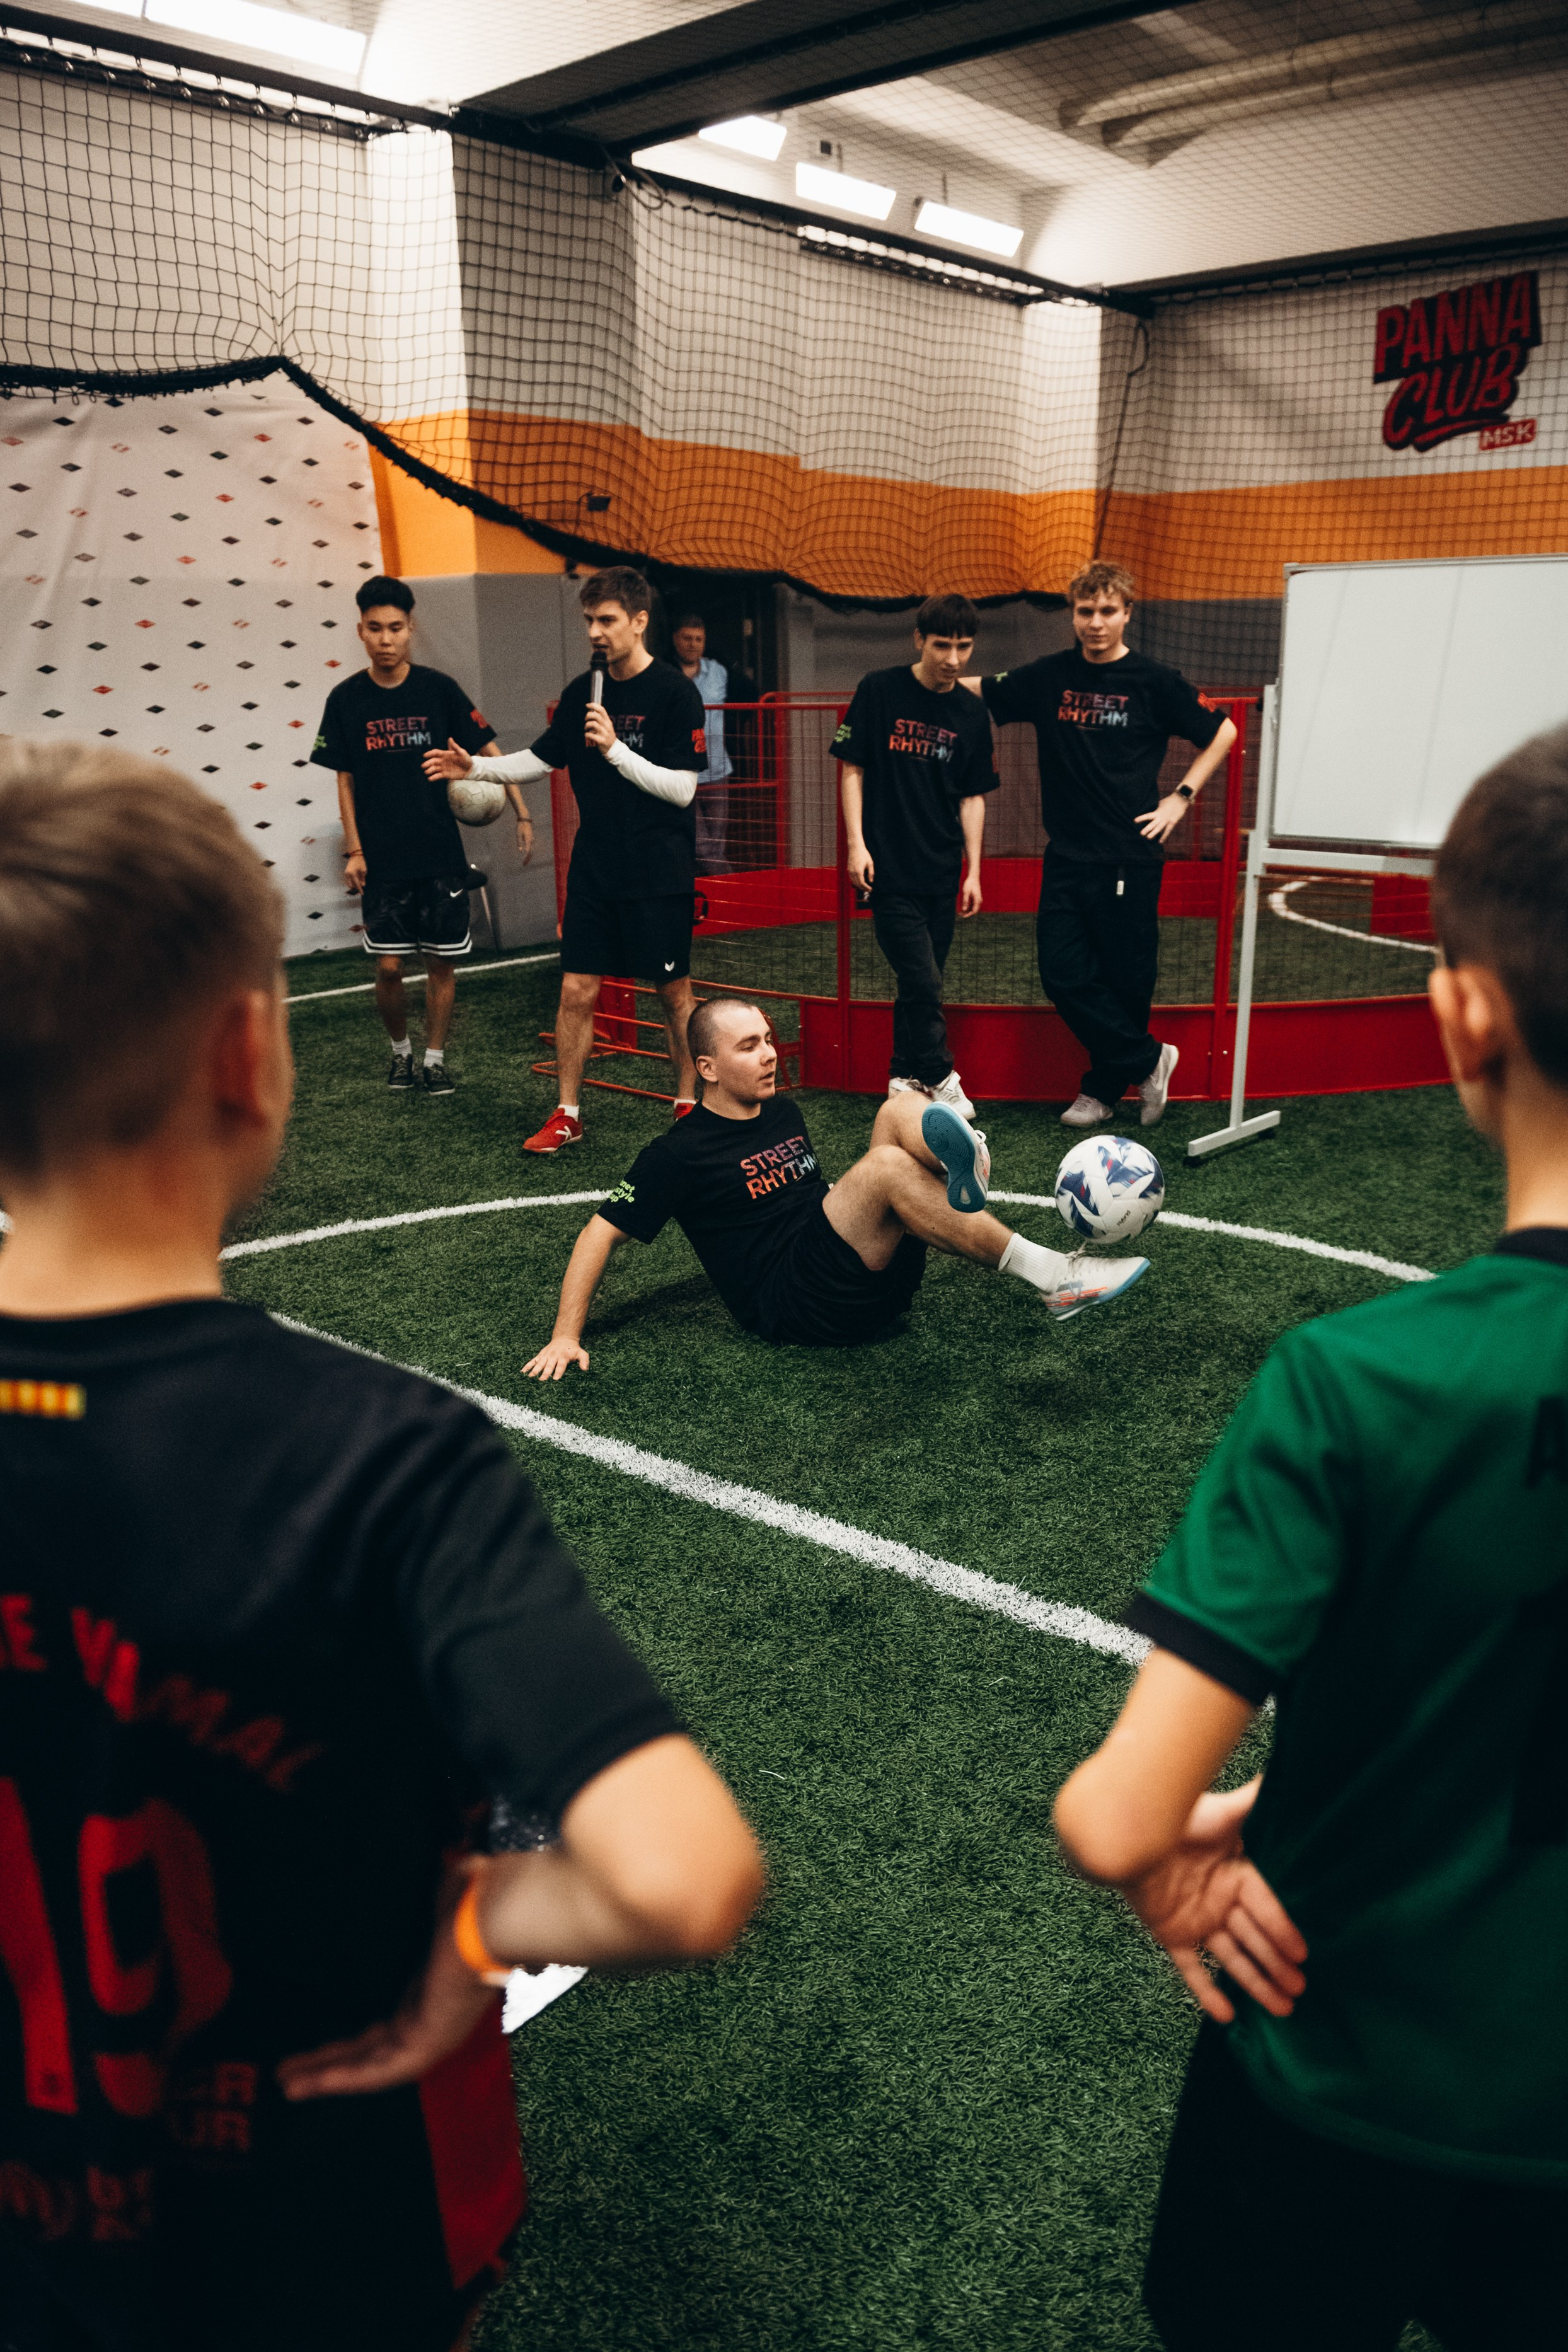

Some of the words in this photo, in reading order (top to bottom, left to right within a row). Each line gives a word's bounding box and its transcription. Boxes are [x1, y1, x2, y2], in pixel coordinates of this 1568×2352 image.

[1375, 271, 1531, 374] PANNA
[1385, 342, 1521, 443] CLUB
[1482, 421, 1533, 446] MSK
[1061, 689, 1129, 711] STREET
[364, 716, 429, 735] STREET
[1057, 705, 1129, 727] RHYTHM
[364, 730, 432, 751] RHYTHM
[893, 718, 958, 747] STREET
[888, 734, 954, 763] RHYTHM
[739, 1135, 810, 1177] STREET
